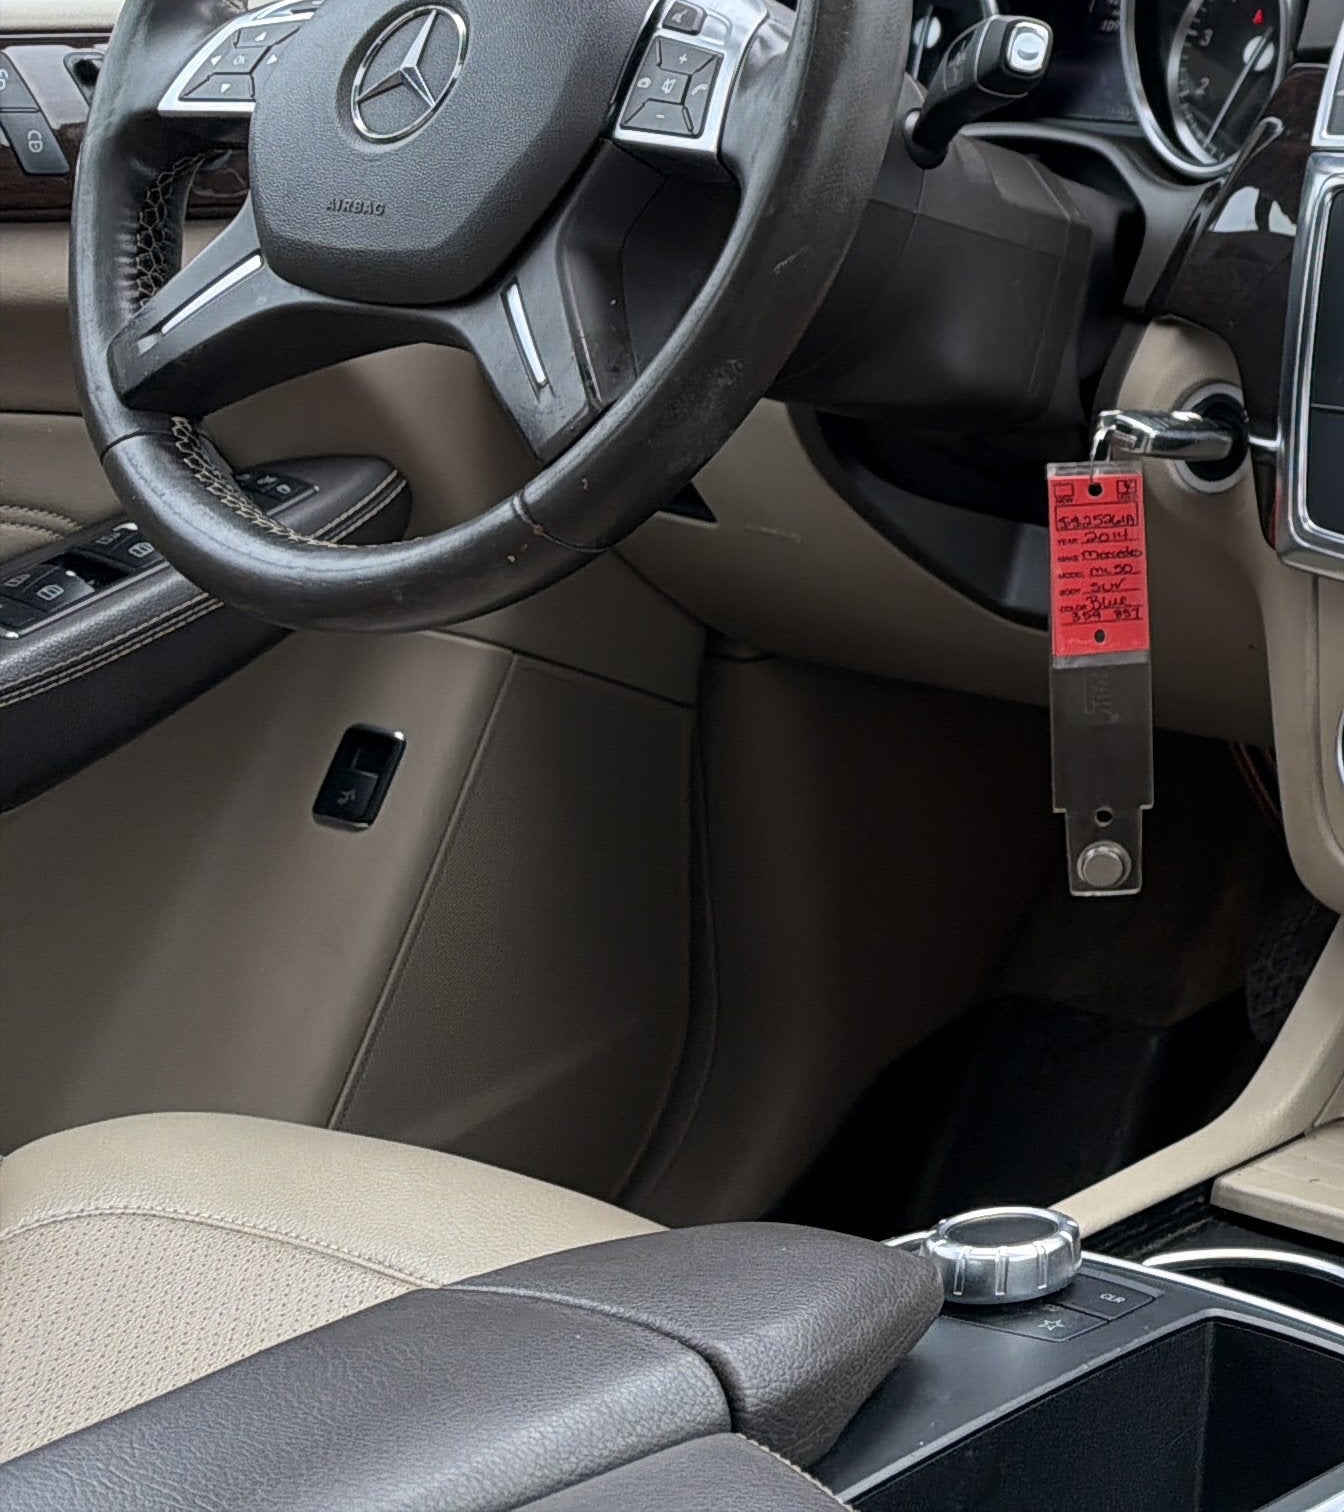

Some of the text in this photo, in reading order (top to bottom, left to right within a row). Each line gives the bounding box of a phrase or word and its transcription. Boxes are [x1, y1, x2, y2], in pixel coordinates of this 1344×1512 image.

[1200, 28, 1214, 48] 3
[326, 199, 386, 216] AIRBAG
[1083, 528, 1129, 543] 2014
[1100, 1292, 1126, 1304] CLR
